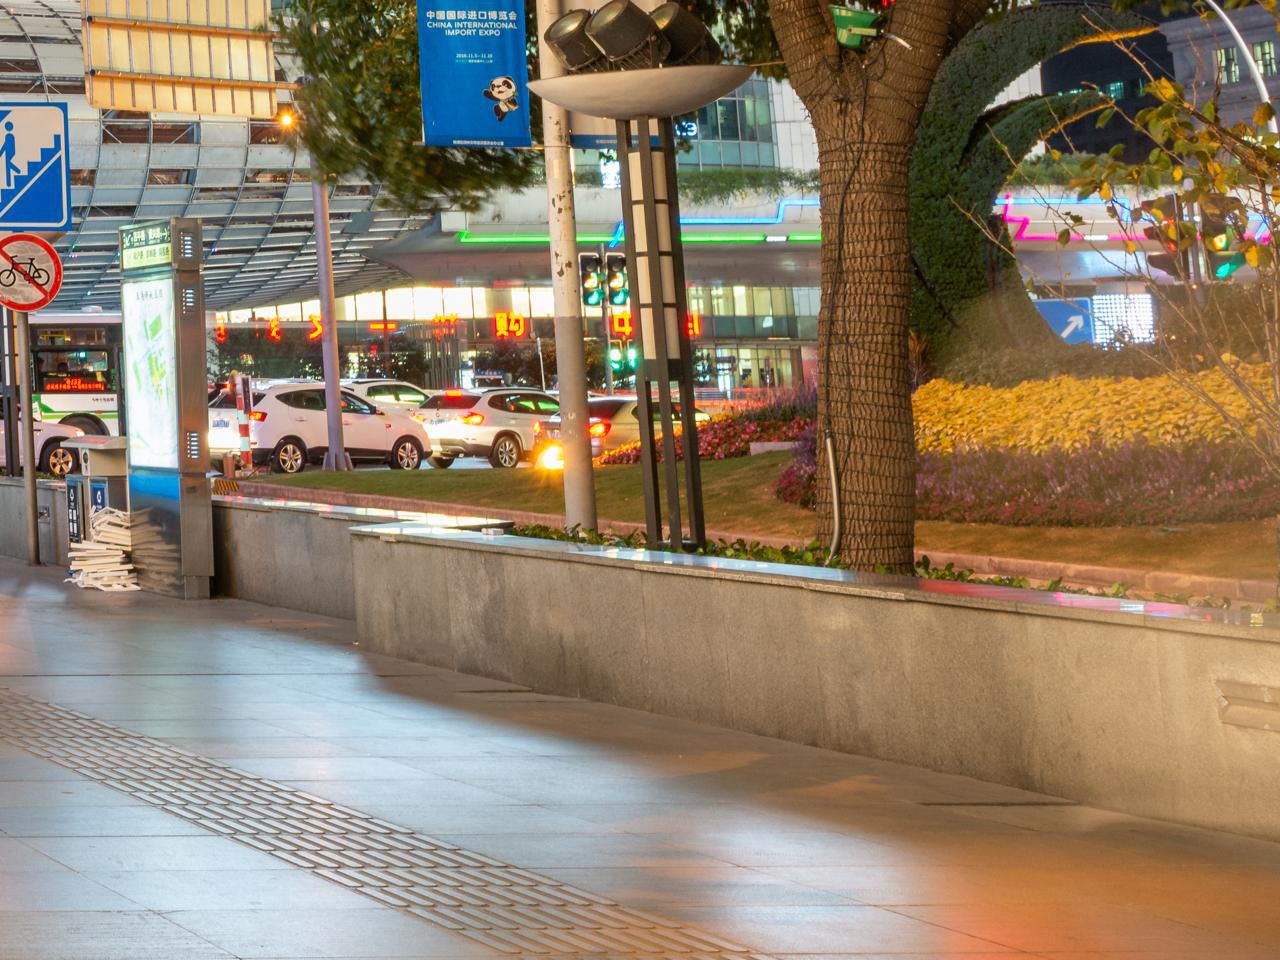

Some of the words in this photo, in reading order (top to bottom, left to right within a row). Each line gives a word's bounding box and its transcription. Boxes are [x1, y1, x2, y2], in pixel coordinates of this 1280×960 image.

[426, 10, 517, 20] 中国国际进口博览会
[455, 21, 517, 29] INTERNATIONAL
